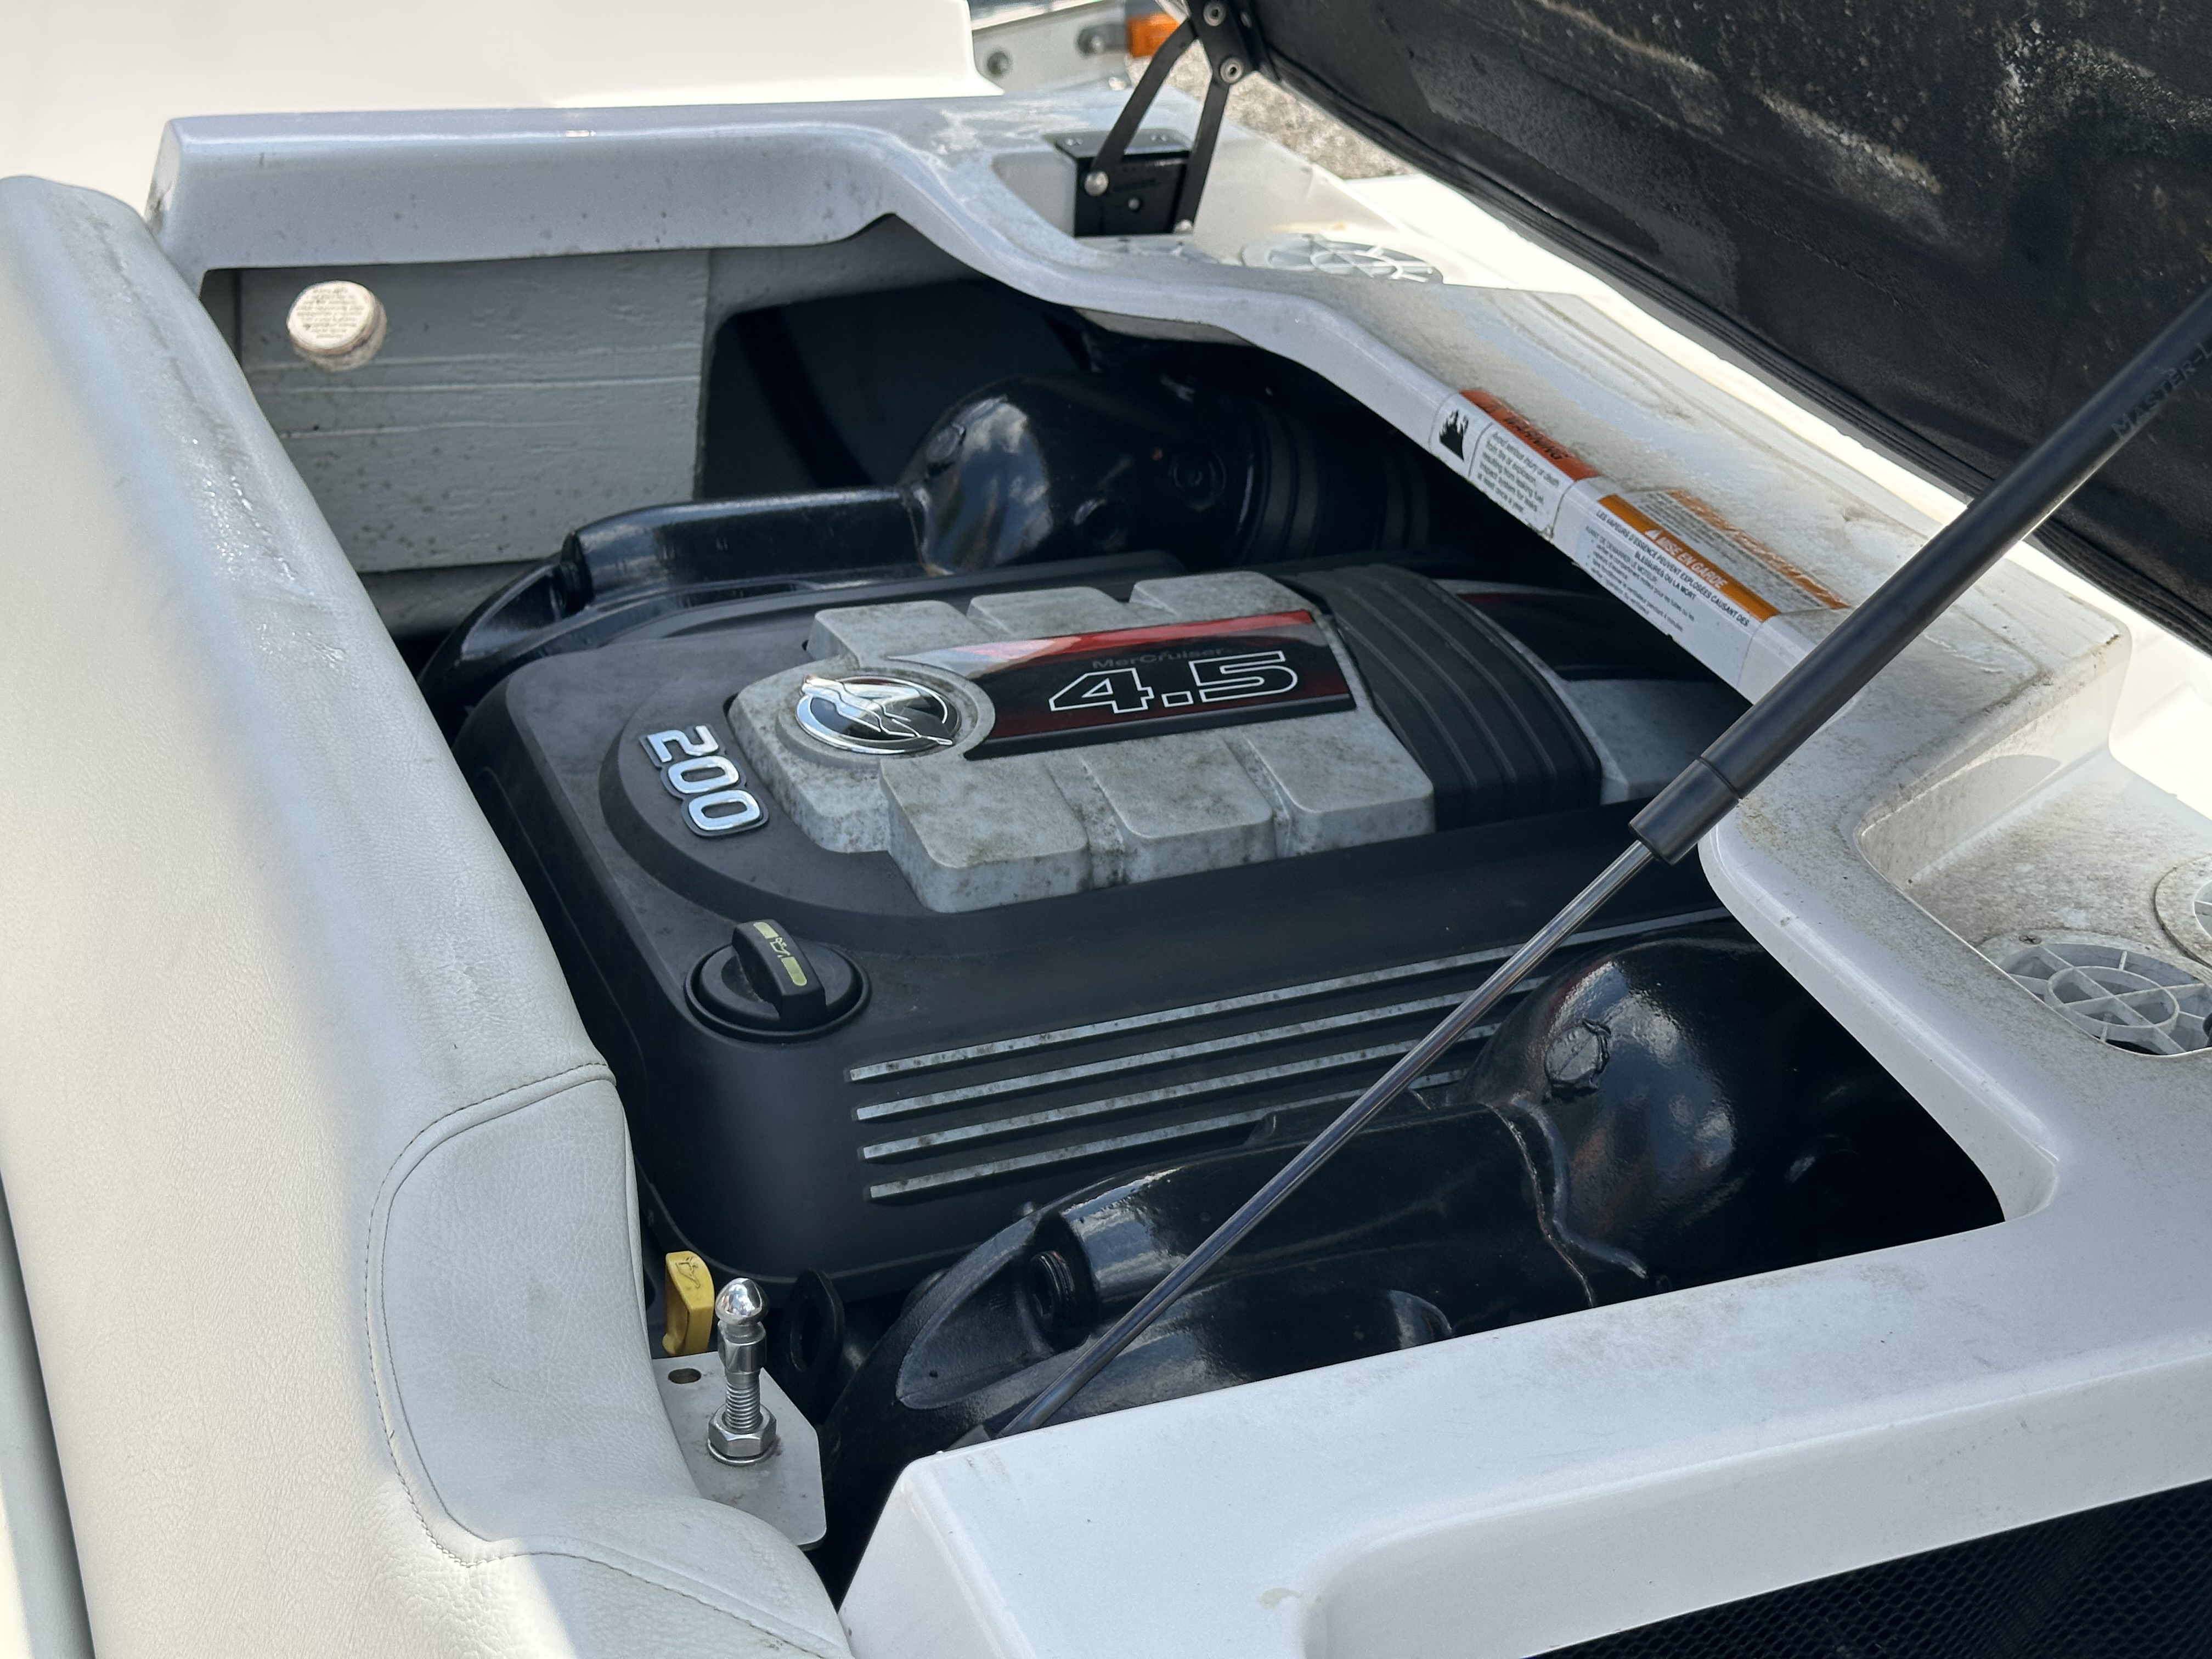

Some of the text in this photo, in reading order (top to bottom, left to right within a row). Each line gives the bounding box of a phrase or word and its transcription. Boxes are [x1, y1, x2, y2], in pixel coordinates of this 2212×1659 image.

[1596, 511, 1607, 521] LES
[1736, 614, 1749, 627] DES
[1635, 552, 1664, 577] BLESSURES
[1664, 574, 1673, 584] OU
[1673, 580, 1680, 589] LA
[1680, 586, 1696, 600] MORT
[1656, 537, 1729, 589] MISE EN GARDE
[1048, 650, 1298, 714] 4.5
[647, 725, 760, 831] 200
